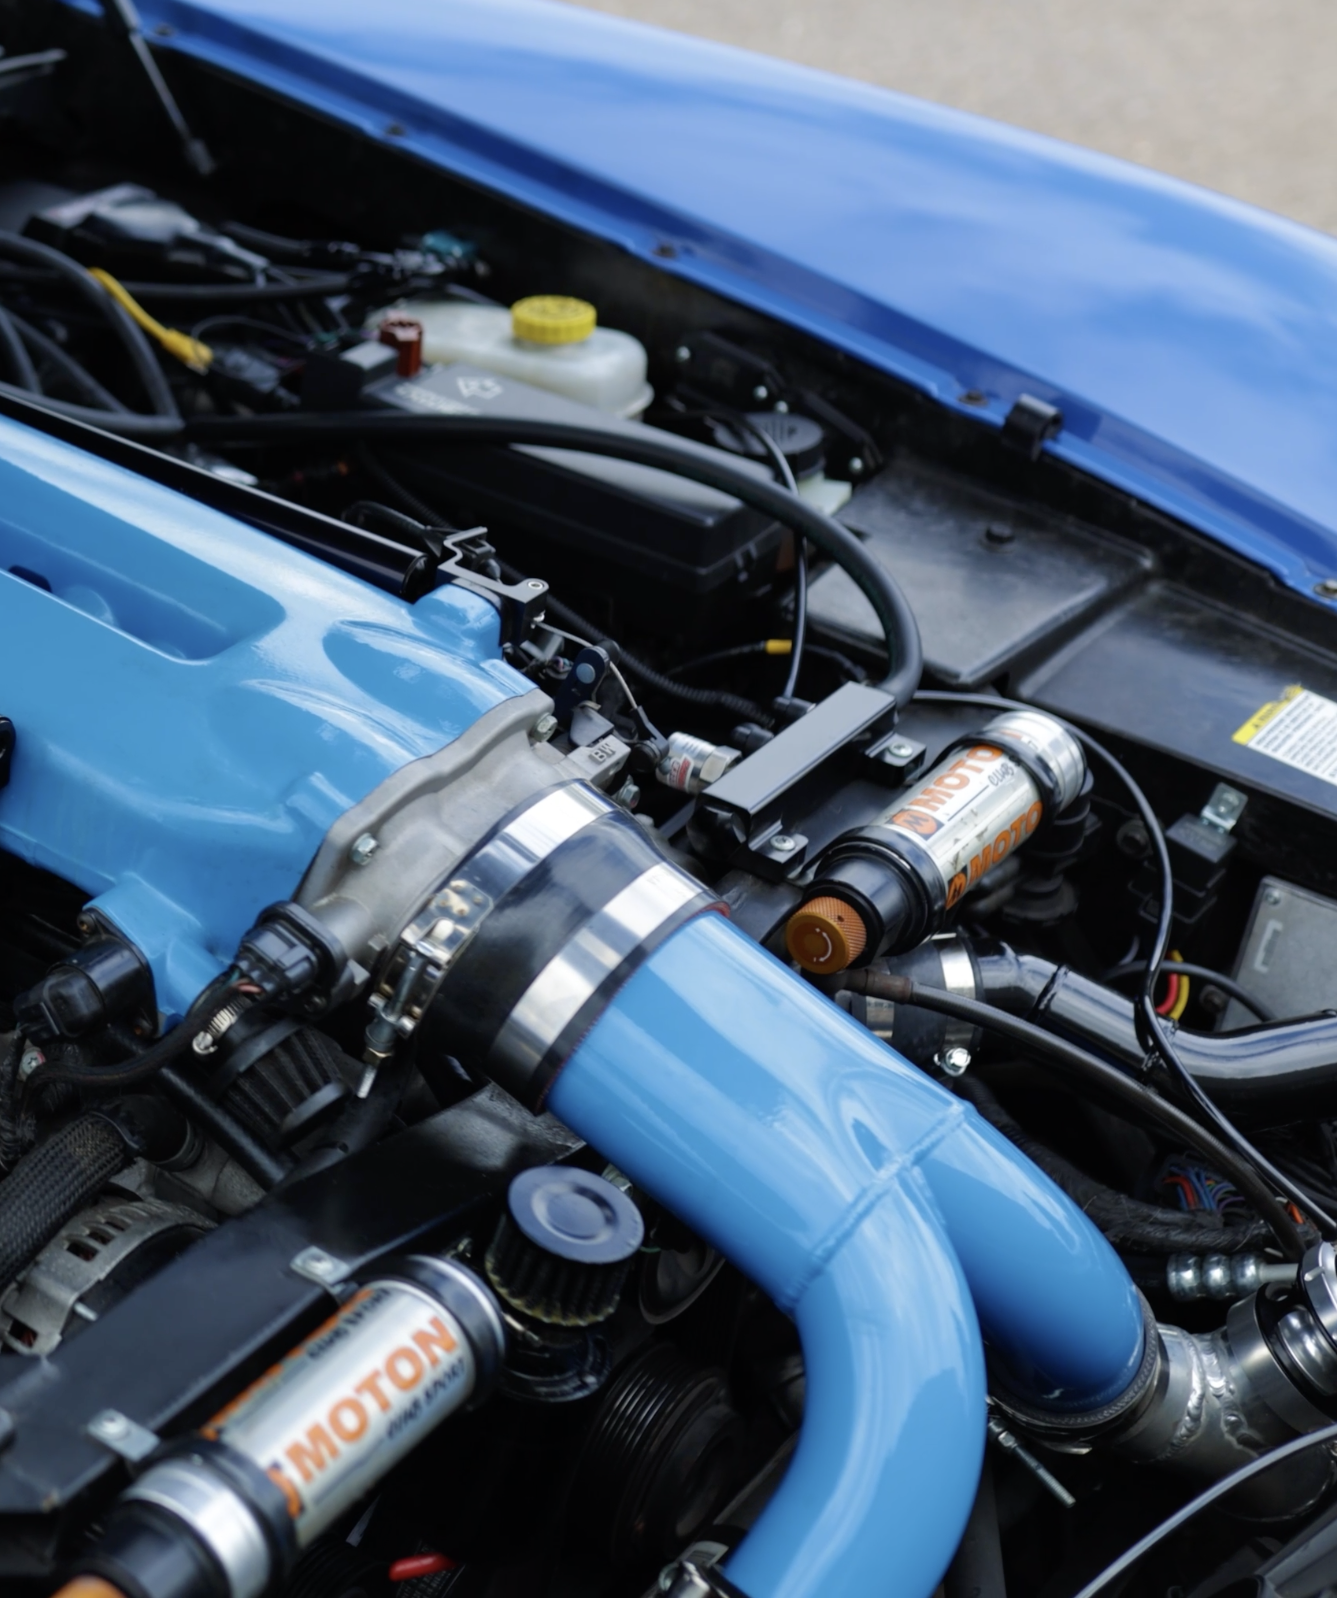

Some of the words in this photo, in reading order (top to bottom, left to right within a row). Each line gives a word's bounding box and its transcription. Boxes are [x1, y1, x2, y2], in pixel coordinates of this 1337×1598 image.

[908, 745, 1004, 812] MOTO
[968, 800, 1043, 886] MOTO
[284, 1316, 458, 1485] MOTON
